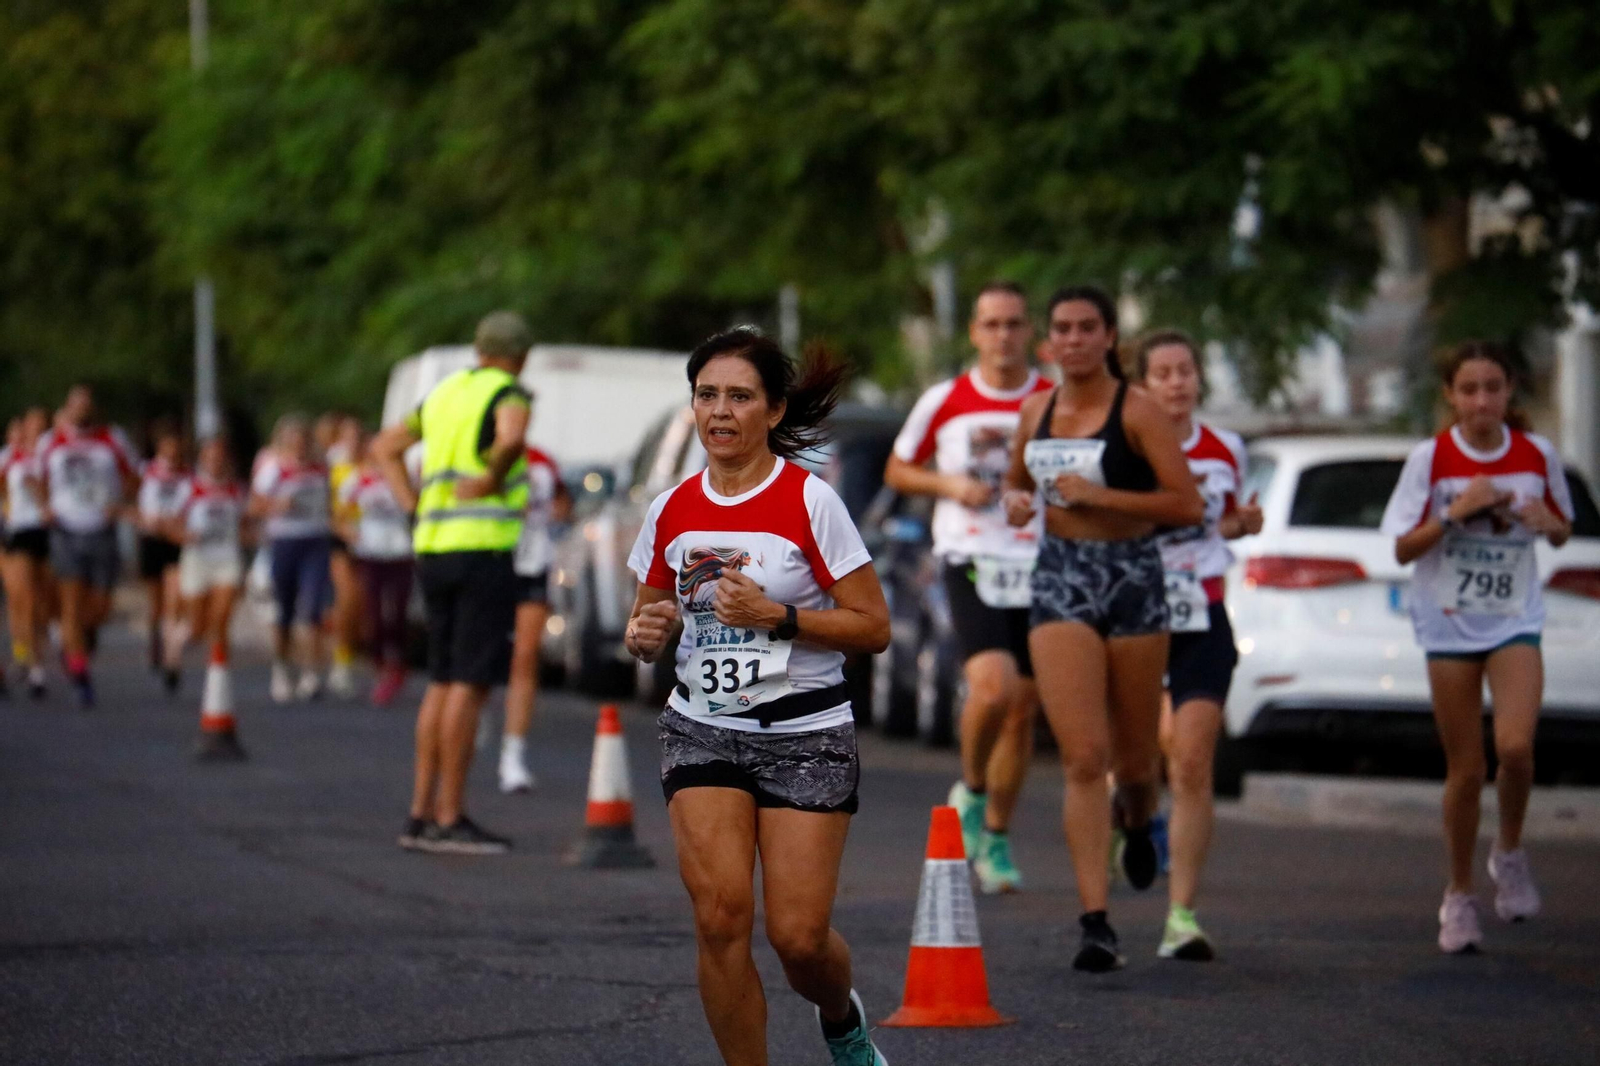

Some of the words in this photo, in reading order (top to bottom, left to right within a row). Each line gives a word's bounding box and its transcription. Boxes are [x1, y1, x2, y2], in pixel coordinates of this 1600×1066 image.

[1456, 568, 1514, 600] 798
[695, 626, 722, 638] 2024
[701, 658, 766, 694] 331
